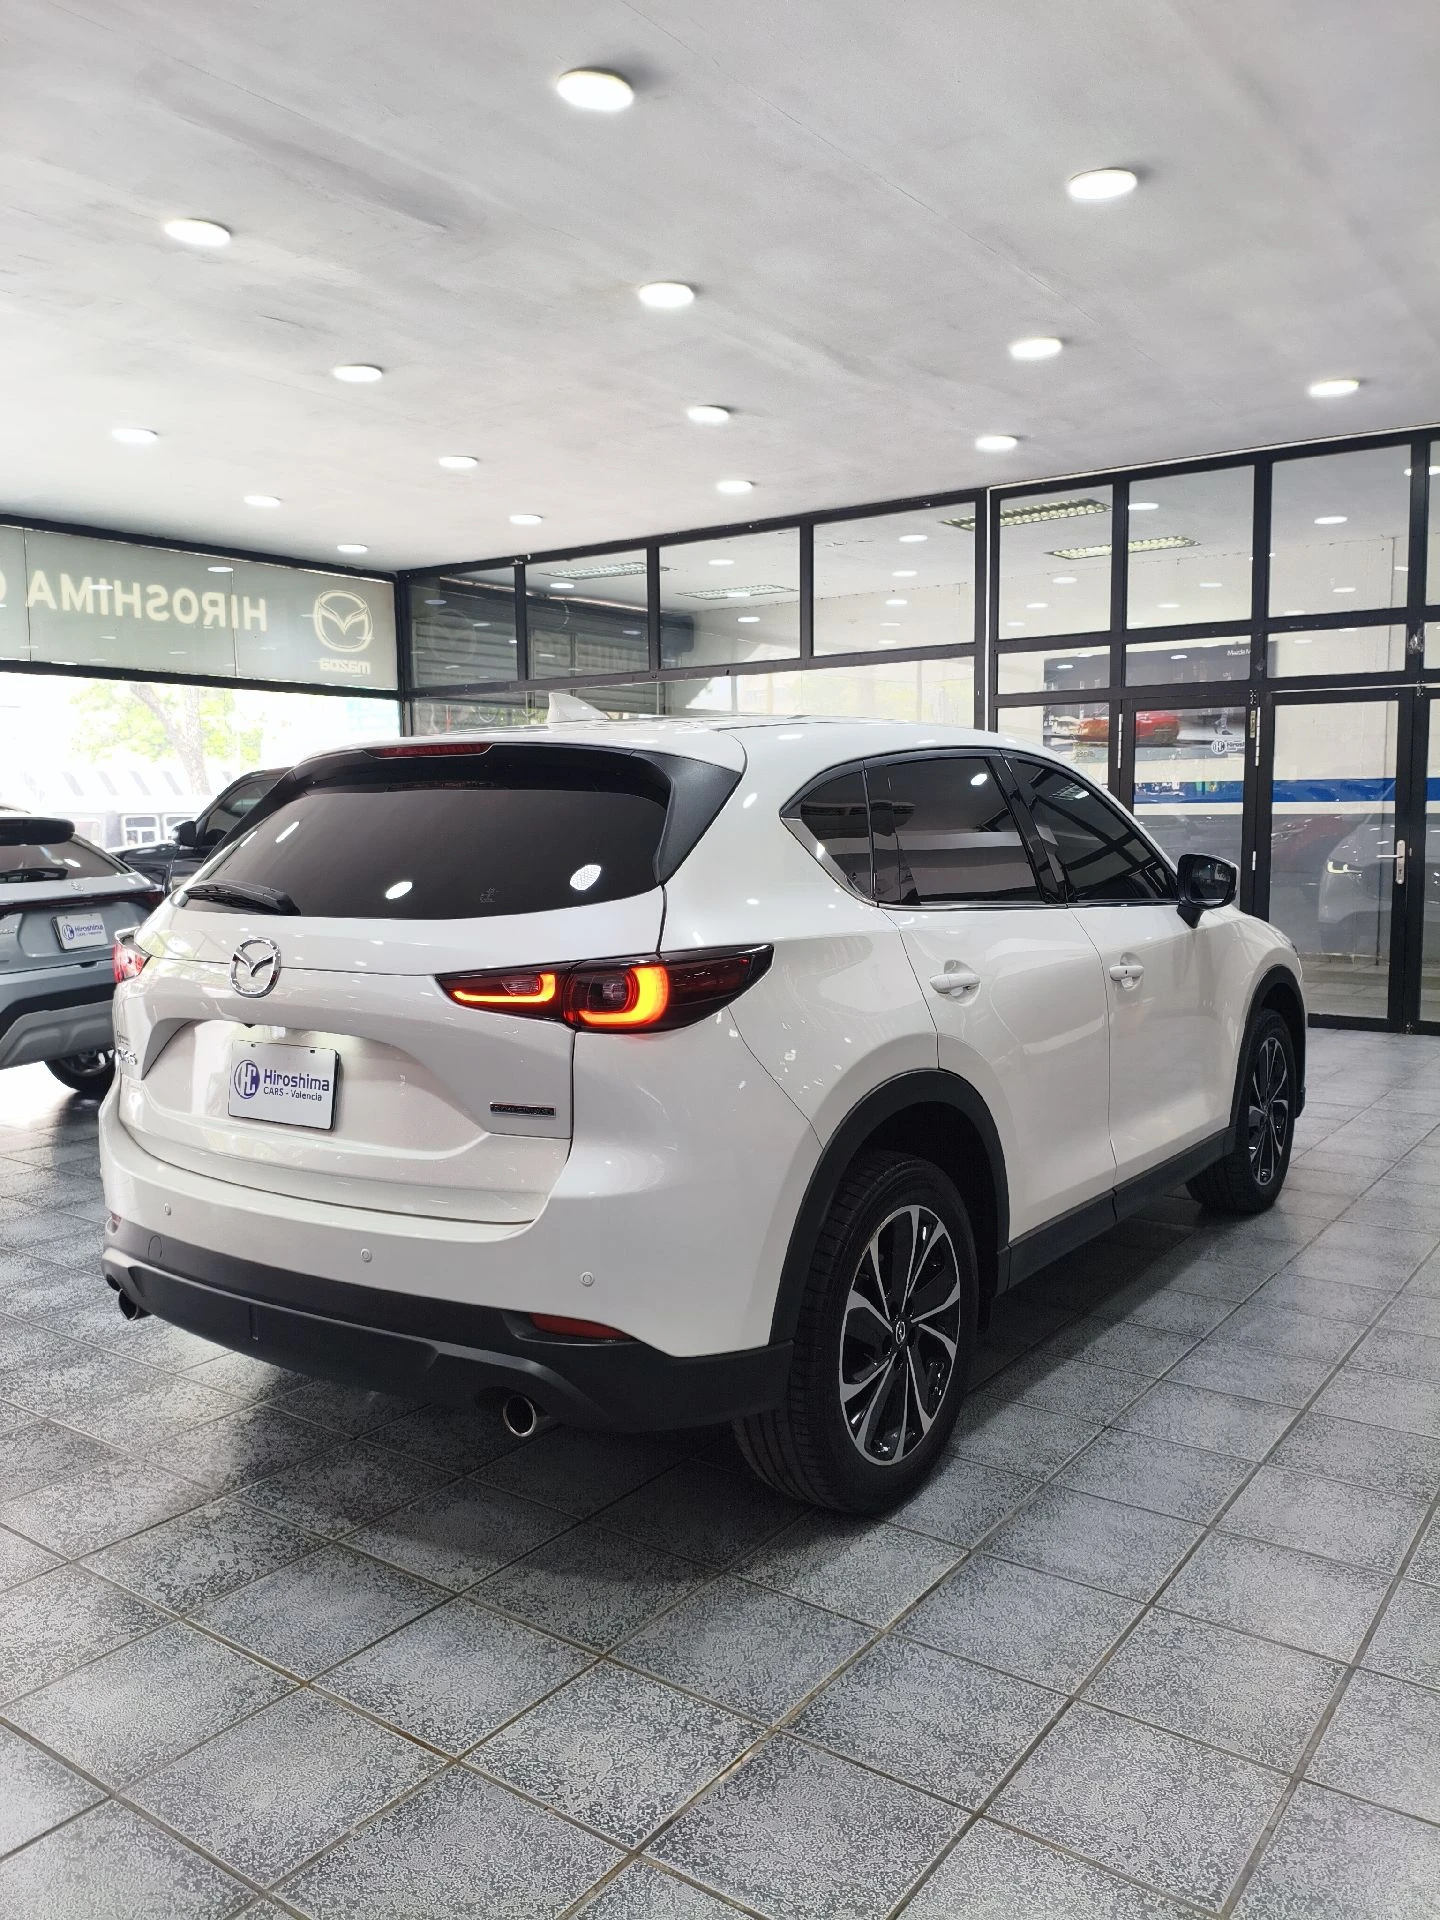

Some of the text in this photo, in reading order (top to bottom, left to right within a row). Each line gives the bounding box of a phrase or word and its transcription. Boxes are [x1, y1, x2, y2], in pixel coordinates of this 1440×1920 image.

[263, 1069, 330, 1092] Hiroshima
[263, 1086, 284, 1097] CARS
[290, 1089, 322, 1102] Valencia
